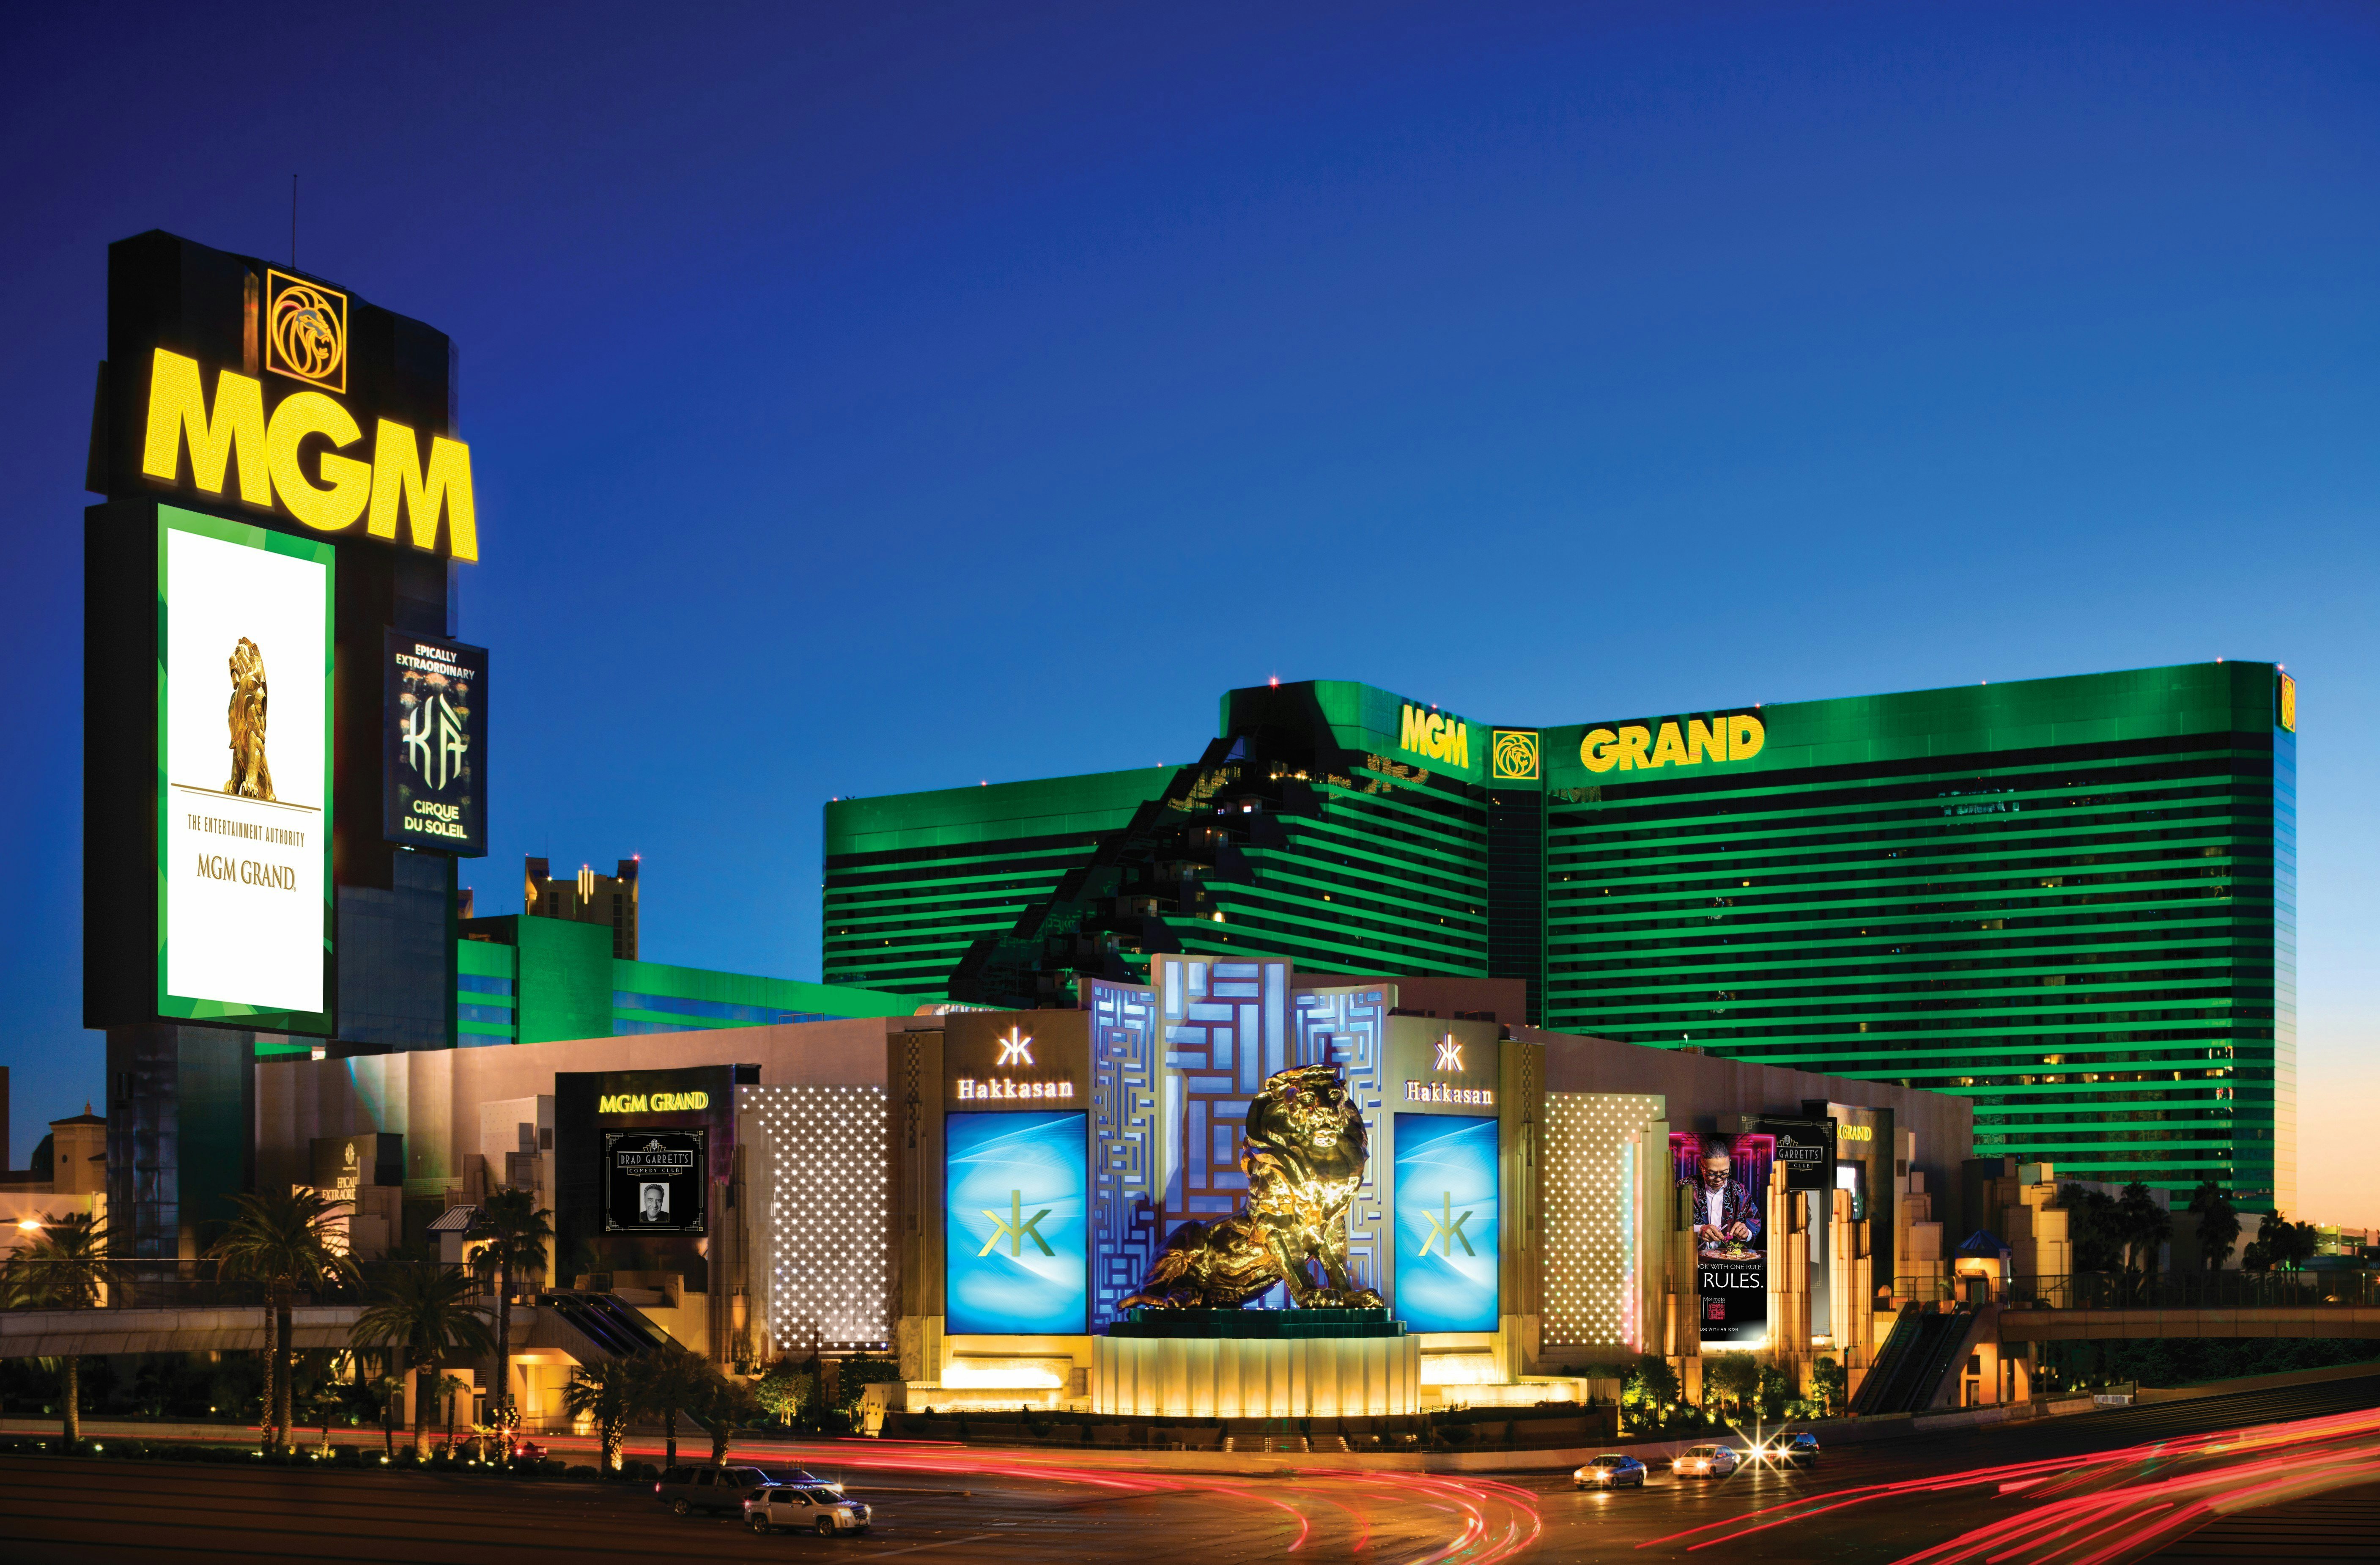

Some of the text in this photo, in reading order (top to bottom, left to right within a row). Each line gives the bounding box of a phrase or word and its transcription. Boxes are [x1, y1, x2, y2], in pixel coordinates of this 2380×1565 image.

[143, 348, 477, 561] MGM
[415, 644, 457, 663] EPICALLY
[396, 653, 475, 680] EXTRAORDINARY
[1401, 704, 1765, 773] MGM GRAND
[413, 800, 459, 821] CIRQUE
[188, 814, 304, 847] THE ENTERTAINMENT AUTHORITY
[405, 816, 467, 839] DU SOLEIL
[197, 853, 237, 882] MGM
[957, 1079, 1074, 1099] Hakkasan
[1404, 1079, 1493, 1104] Hakkasan
[599, 1091, 709, 1113] MGM GRAND
[1842, 1124, 1872, 1141] GRAND
[621, 1154, 688, 1164] BRAD GARRETT'S
[1779, 1149, 1818, 1159] GARRETT'S
[1704, 1273, 1764, 1288] RULES.
